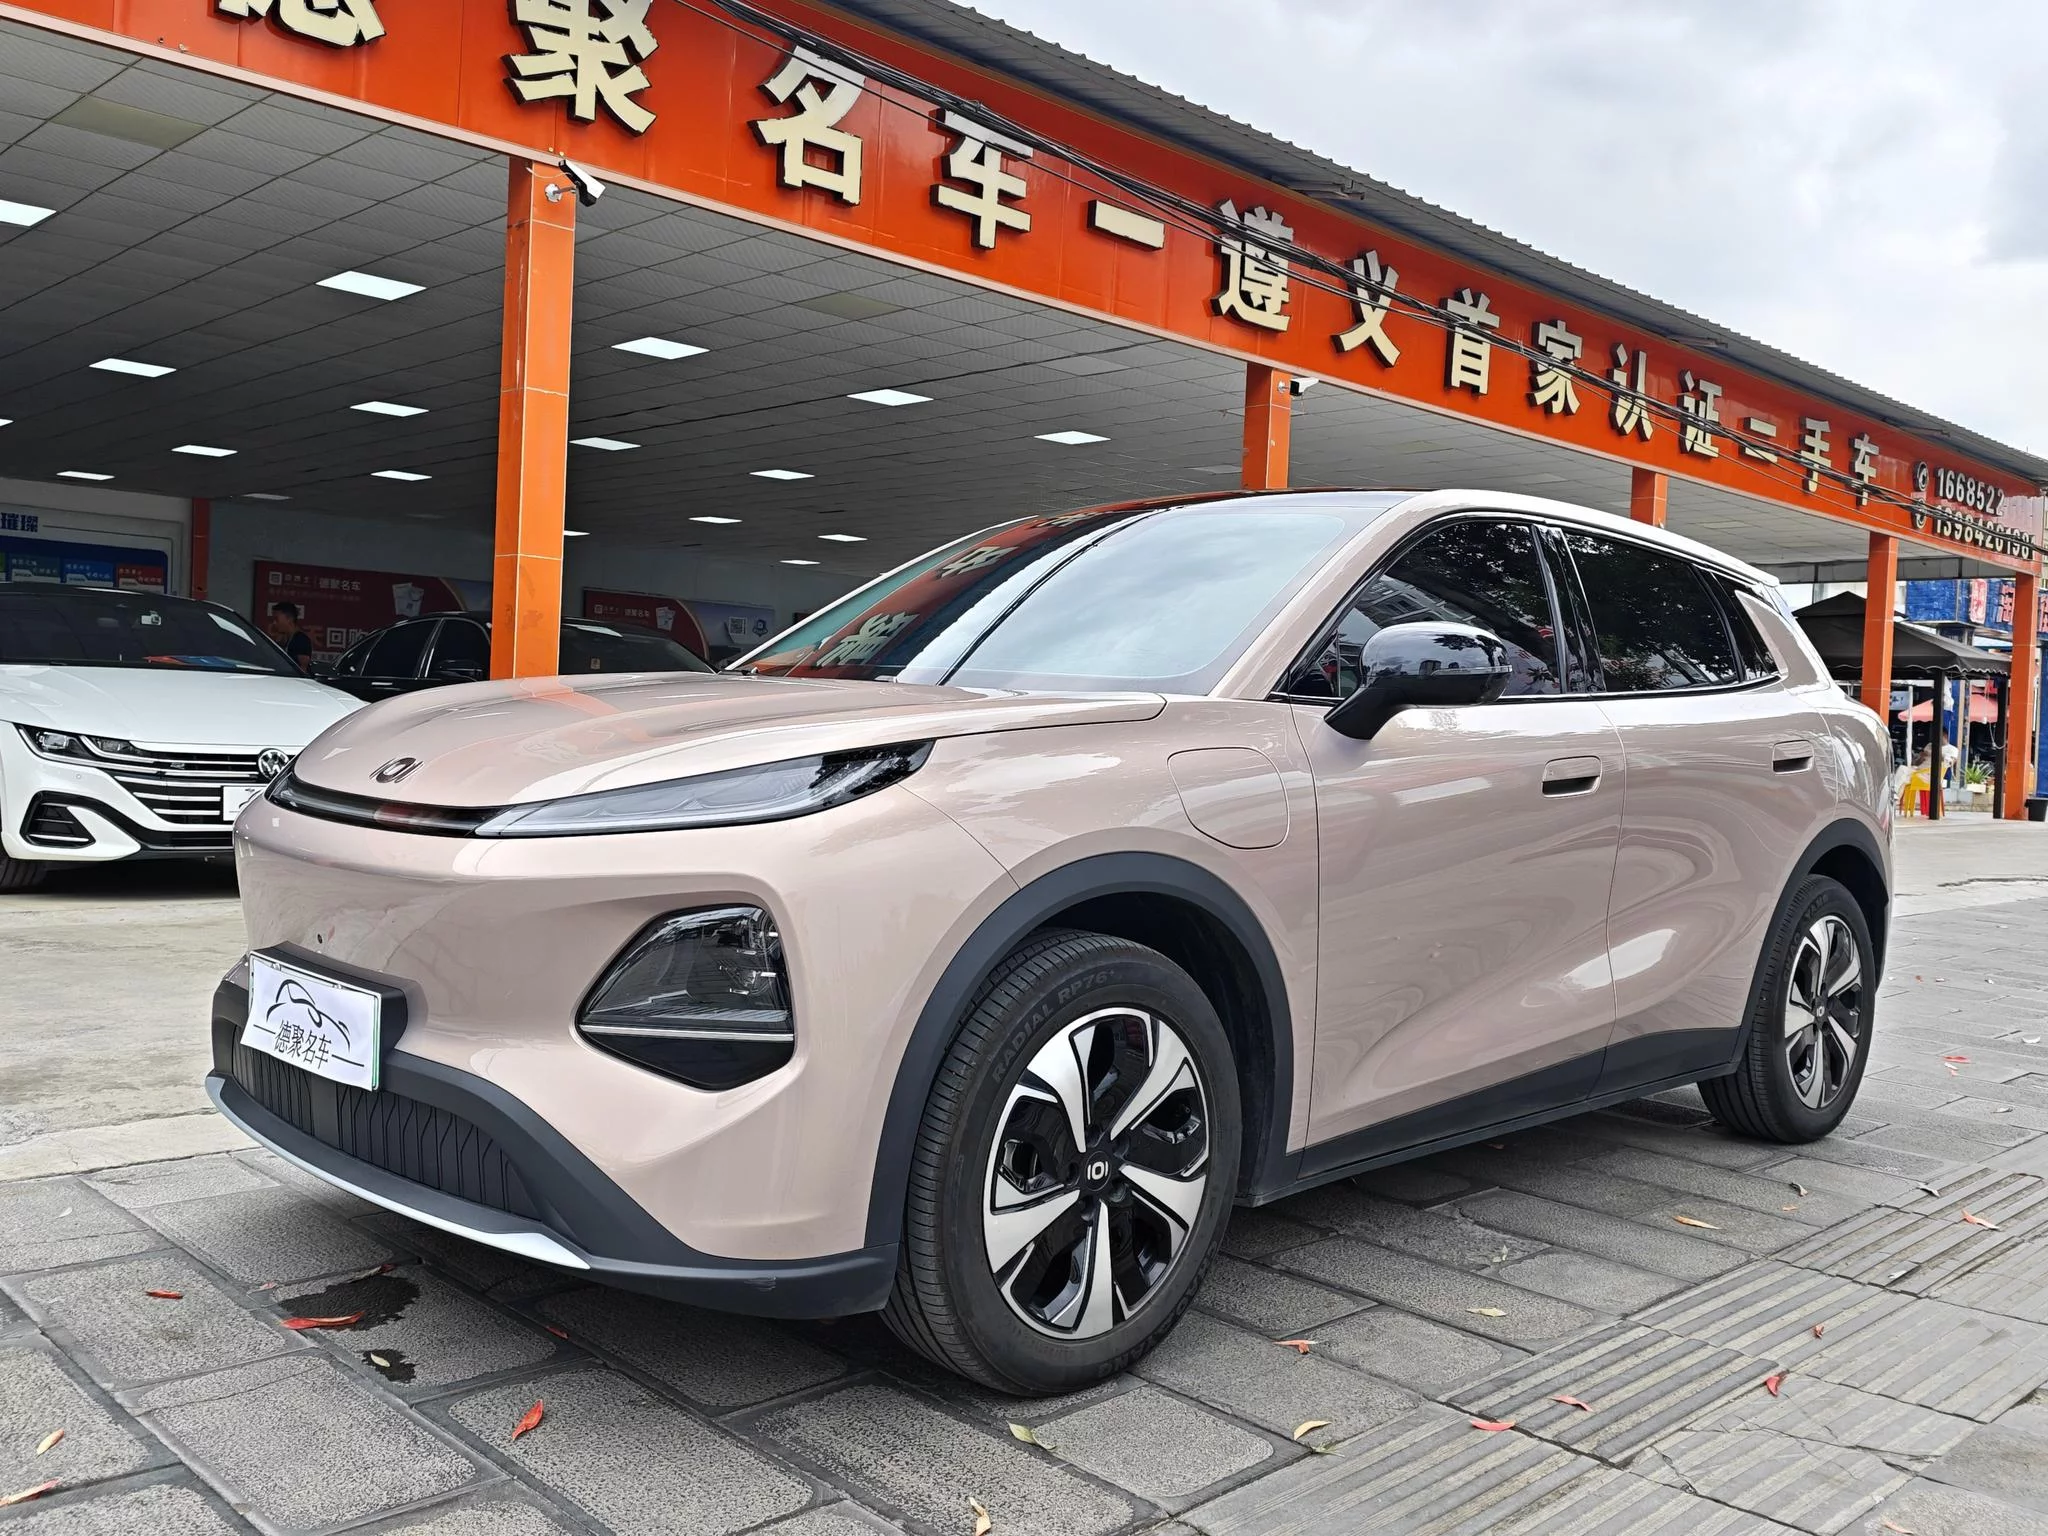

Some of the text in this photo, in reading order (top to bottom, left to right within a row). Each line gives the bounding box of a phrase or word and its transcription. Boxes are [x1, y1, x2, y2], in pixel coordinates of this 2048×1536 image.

[207, 0, 1880, 506] 聚名车一遵义首家认证二手车
[1937, 467, 2005, 516] 1668522
[274, 1019, 332, 1070] 德聚名车
[992, 1004, 1053, 1084] RADIAL
